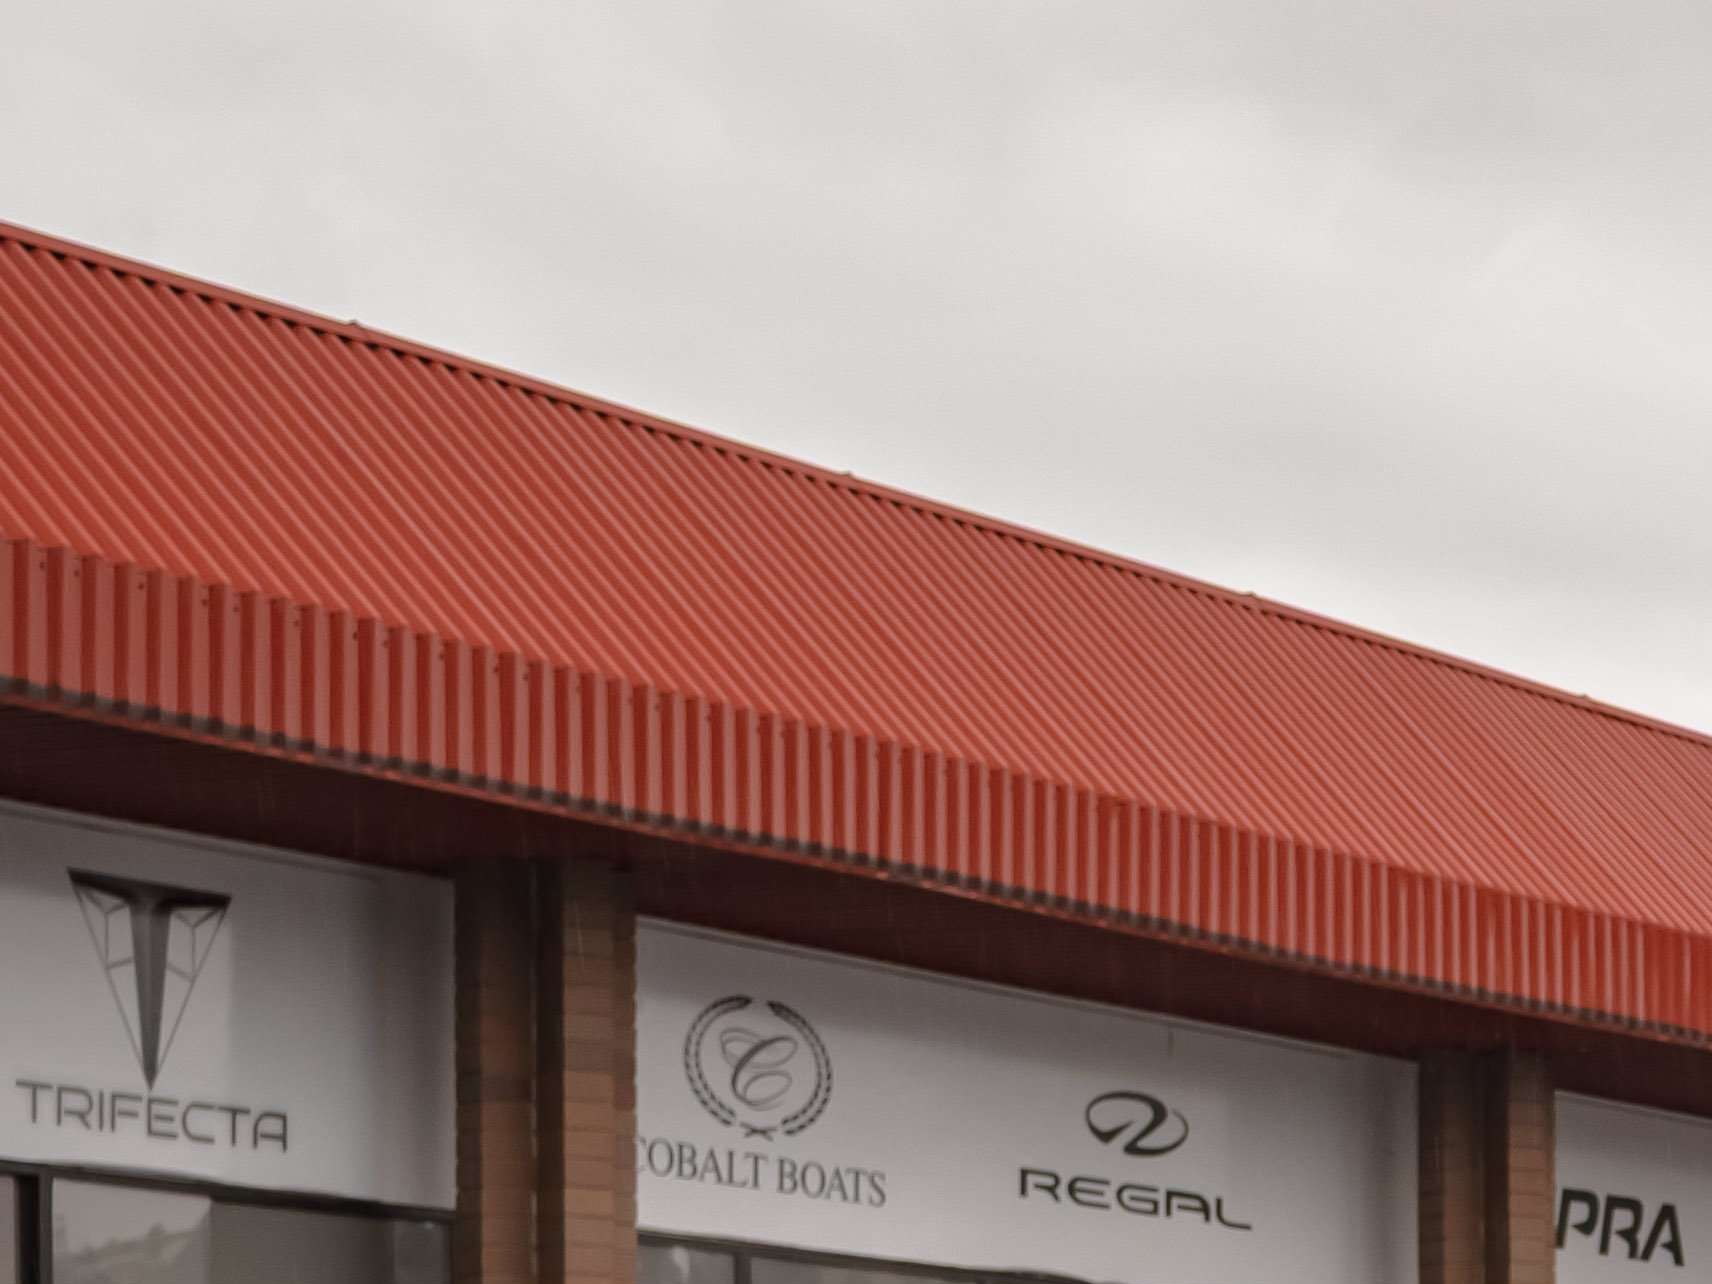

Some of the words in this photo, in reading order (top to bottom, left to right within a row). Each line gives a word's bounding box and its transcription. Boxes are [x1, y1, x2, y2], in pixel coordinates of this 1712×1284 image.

[15, 1079, 289, 1153] TRIFECTA
[777, 1154, 887, 1208] BOATS
[1019, 1166, 1253, 1230] REGAL
[1555, 1187, 1686, 1267] PRA
